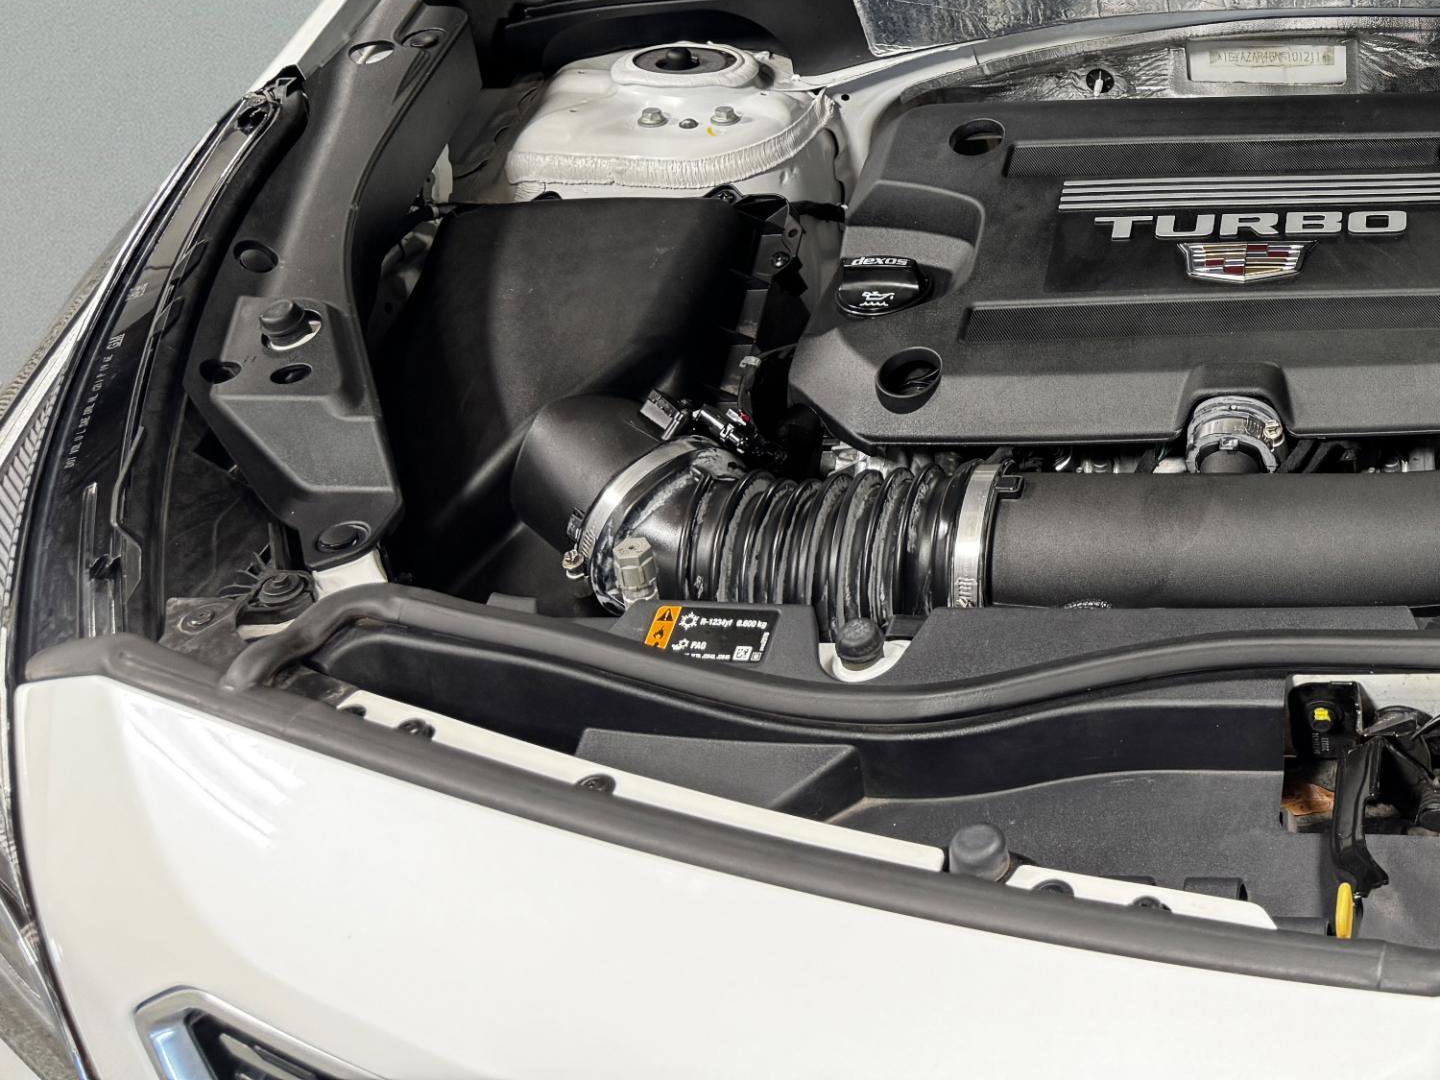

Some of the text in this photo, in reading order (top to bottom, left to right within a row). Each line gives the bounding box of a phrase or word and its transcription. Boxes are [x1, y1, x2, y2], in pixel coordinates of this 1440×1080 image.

[1094, 211, 1408, 241] TURBO
[851, 256, 909, 266] dexos
[700, 617, 733, 628] R-1234yf
[757, 620, 768, 630] kg
